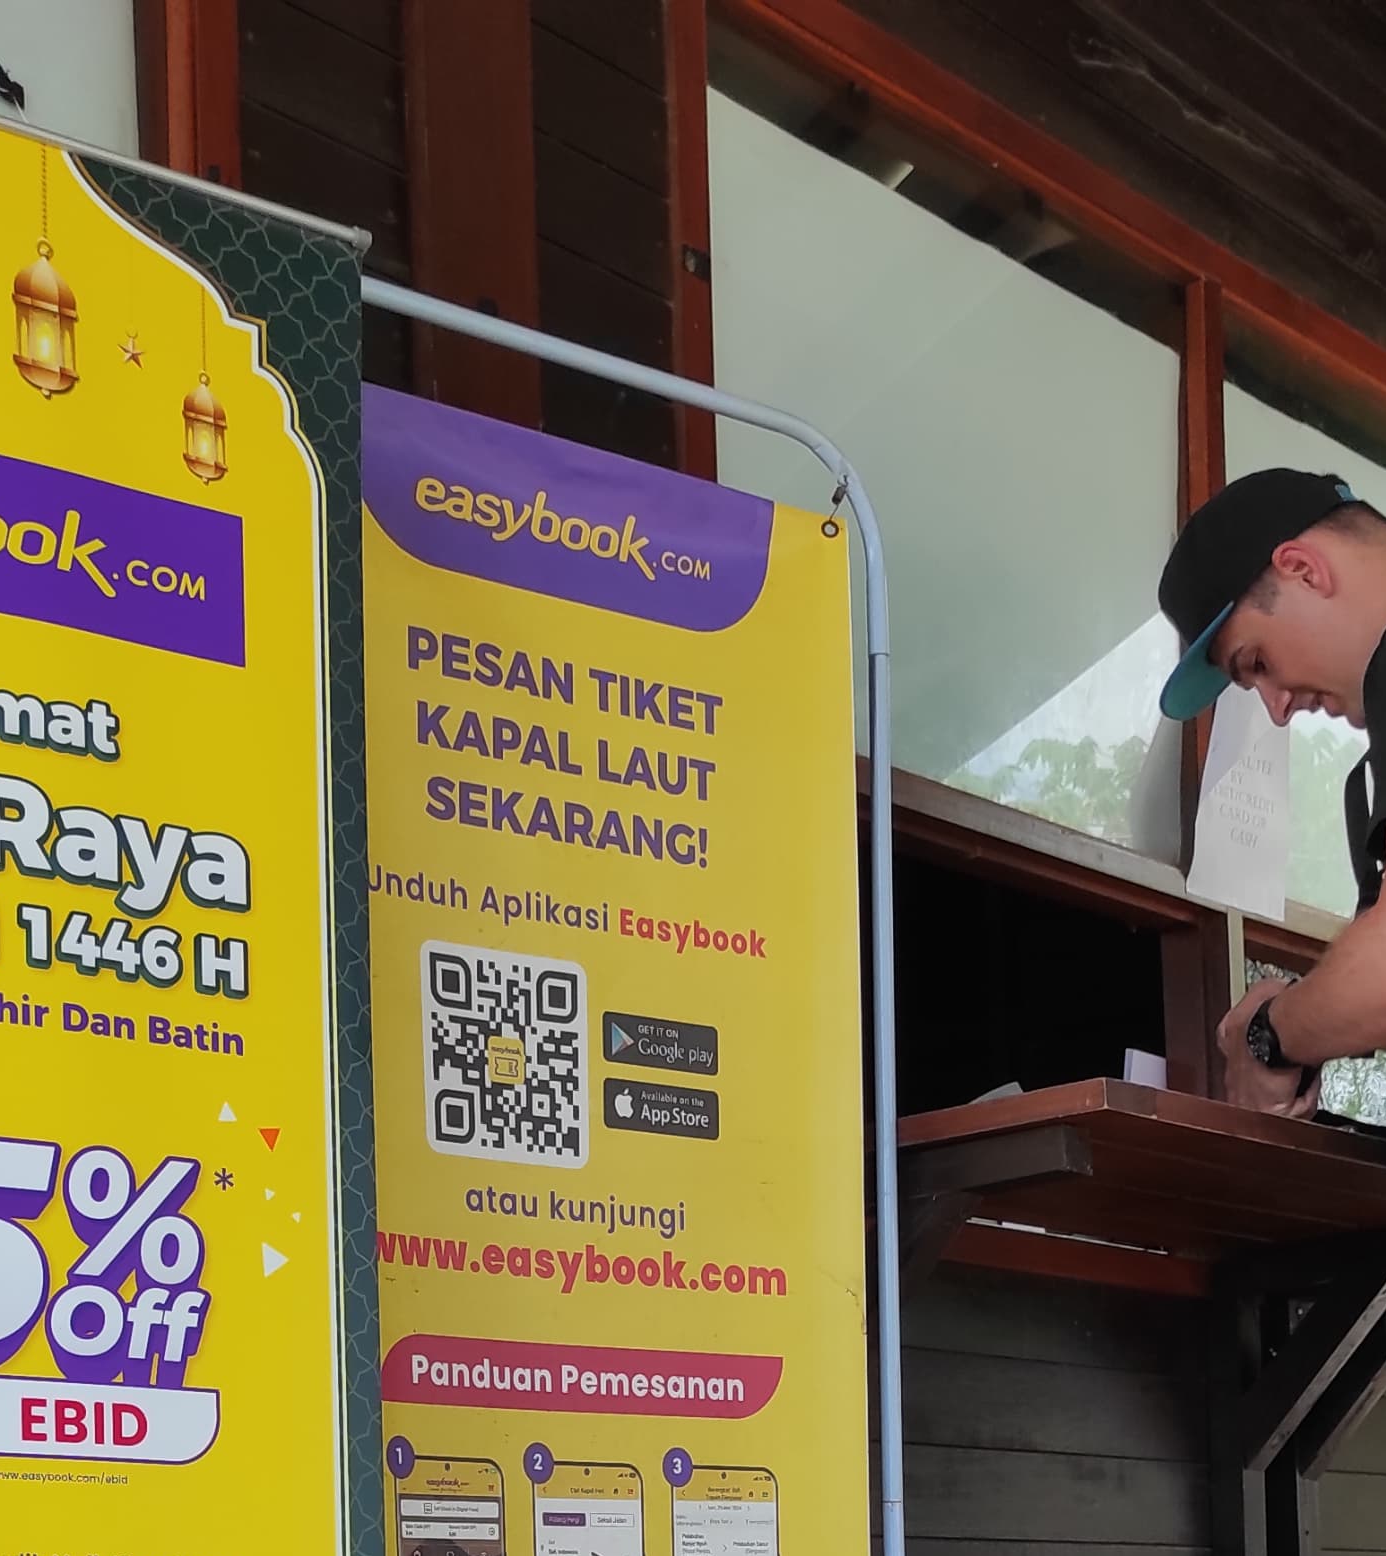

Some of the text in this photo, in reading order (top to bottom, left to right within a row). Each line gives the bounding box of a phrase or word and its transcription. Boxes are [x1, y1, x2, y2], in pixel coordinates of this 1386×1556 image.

[406, 624, 723, 736] PESAN TIKET
[415, 699, 717, 802] KAPAL LAUT
[424, 773, 709, 869] SEKARANG!
[479, 884, 610, 932] Aplikasi
[618, 907, 767, 959] Easybook
[16, 900, 182, 987] 1446
[193, 933, 249, 1000] H
[61, 1003, 137, 1042] Dan
[147, 1016, 245, 1056] Batin
[637, 1024, 679, 1039] GET IT ON
[637, 1037, 714, 1068] Google play
[640, 1090, 705, 1108] Available on the
[640, 1103, 710, 1128] App Store
[464, 1185, 687, 1239] atau kunjungi
[47, 1283, 208, 1366] Off
[411, 1353, 745, 1402] Panduan Pemesanan
[20, 1396, 148, 1447] EBID
[395, 1447, 403, 1465] 1
[532, 1453, 543, 1470] 2
[672, 1457, 683, 1475] 3
